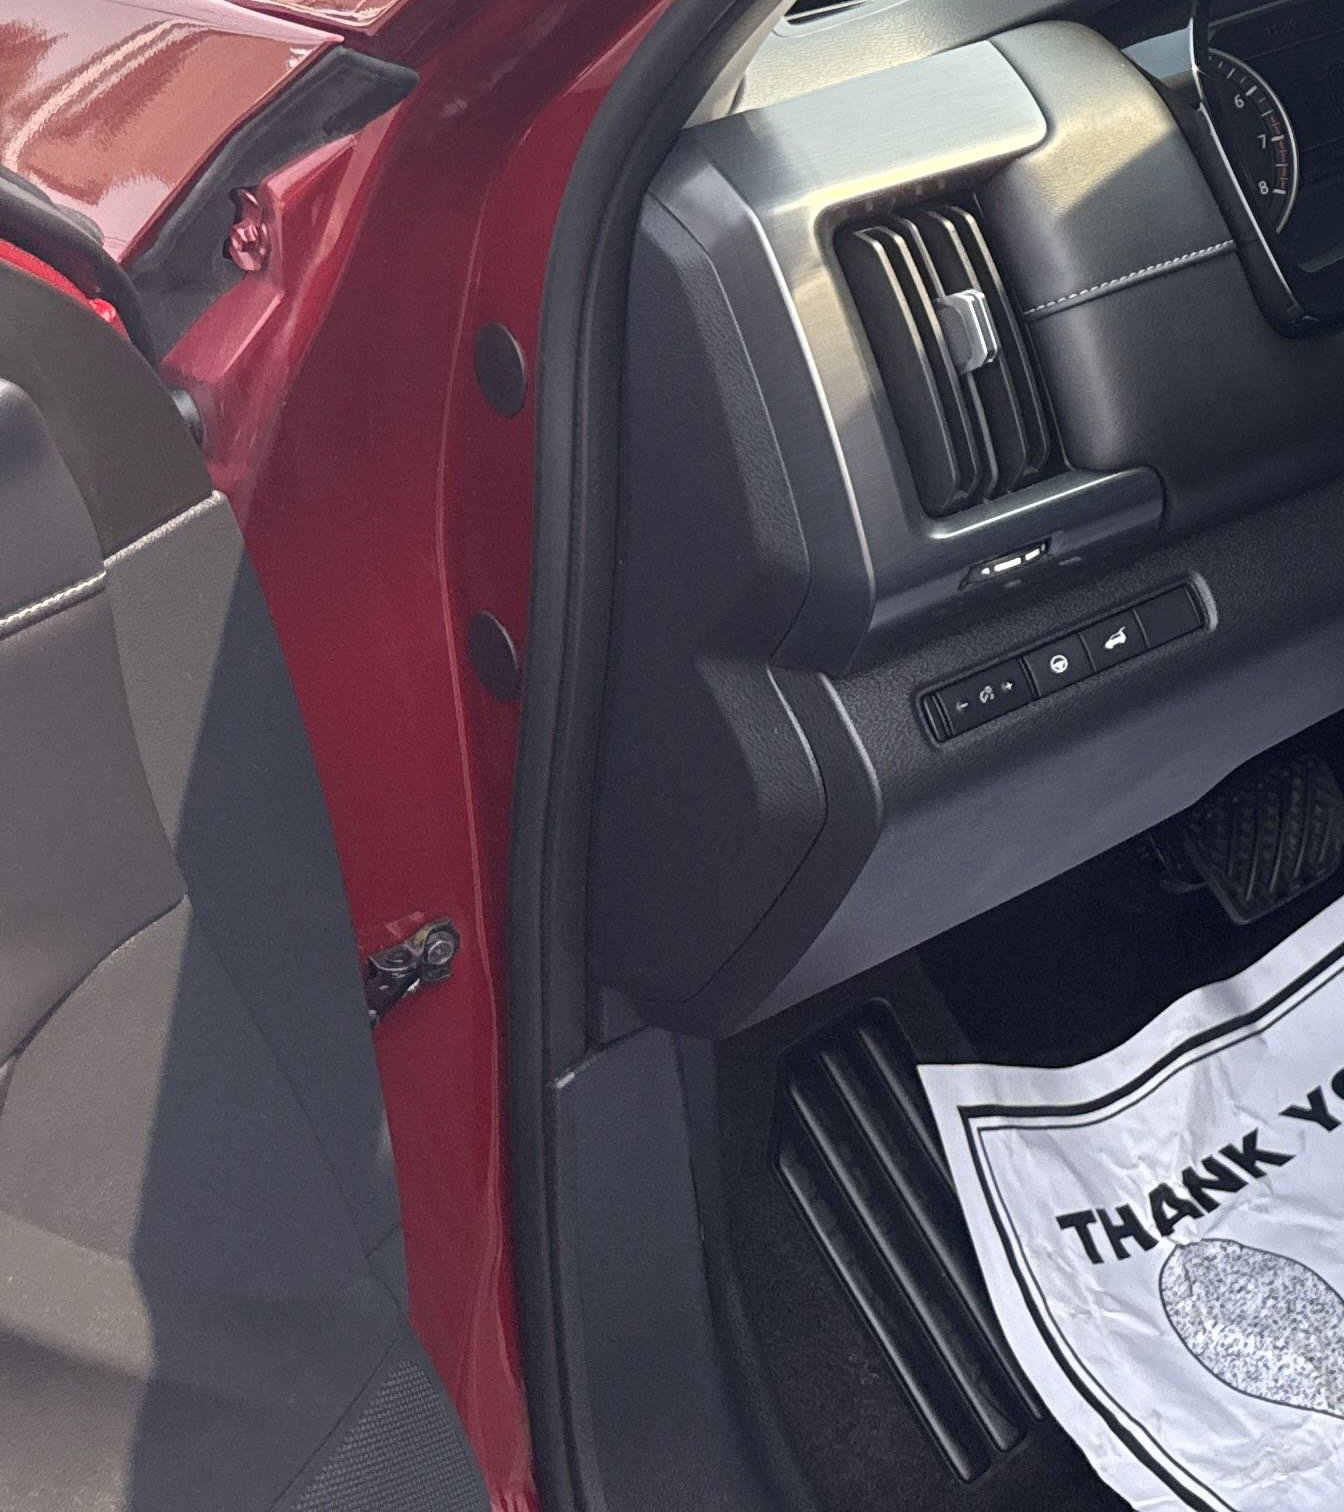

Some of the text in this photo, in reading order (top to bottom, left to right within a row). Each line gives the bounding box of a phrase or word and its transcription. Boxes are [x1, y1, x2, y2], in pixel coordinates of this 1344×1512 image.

[1234, 94, 1245, 109] 6
[1257, 134, 1267, 149] 7
[1258, 180, 1269, 196] 8
[1056, 1128, 1295, 1264] THANK
